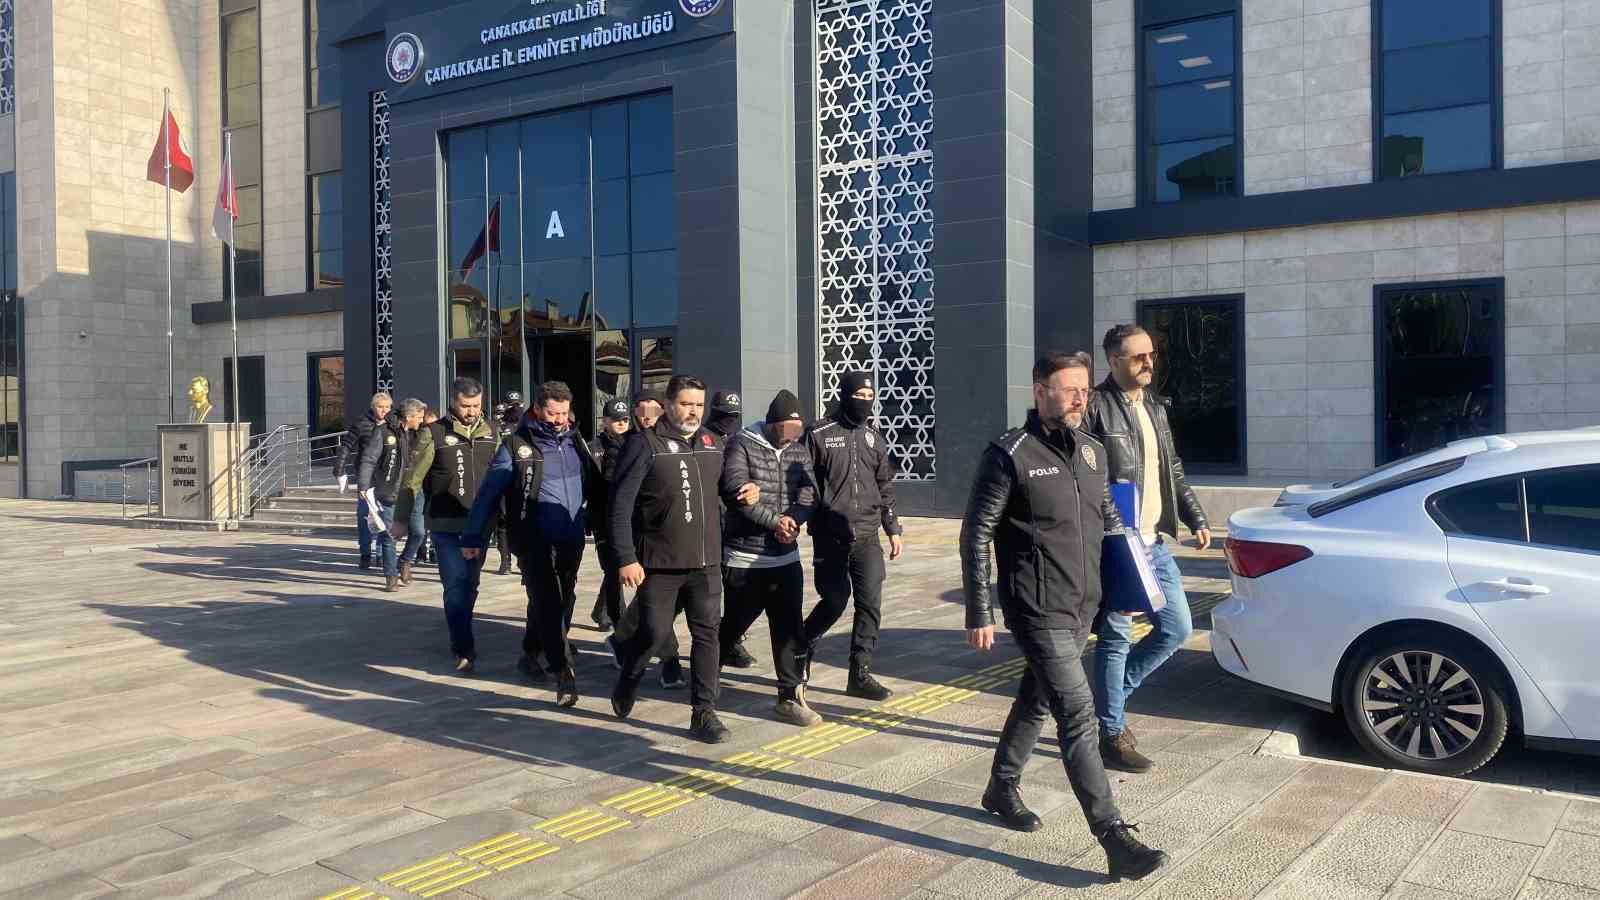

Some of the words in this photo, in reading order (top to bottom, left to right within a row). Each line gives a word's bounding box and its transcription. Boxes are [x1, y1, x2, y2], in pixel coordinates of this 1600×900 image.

[480, 14, 551, 45] ÇANAKKALE
[424, 53, 500, 85] ÇANAKKALE
[502, 48, 515, 67] İL
[517, 37, 579, 64] EMNİYET
[580, 11, 674, 50] MÜDÜRLÜĞÜ
[545, 210, 565, 239] A
